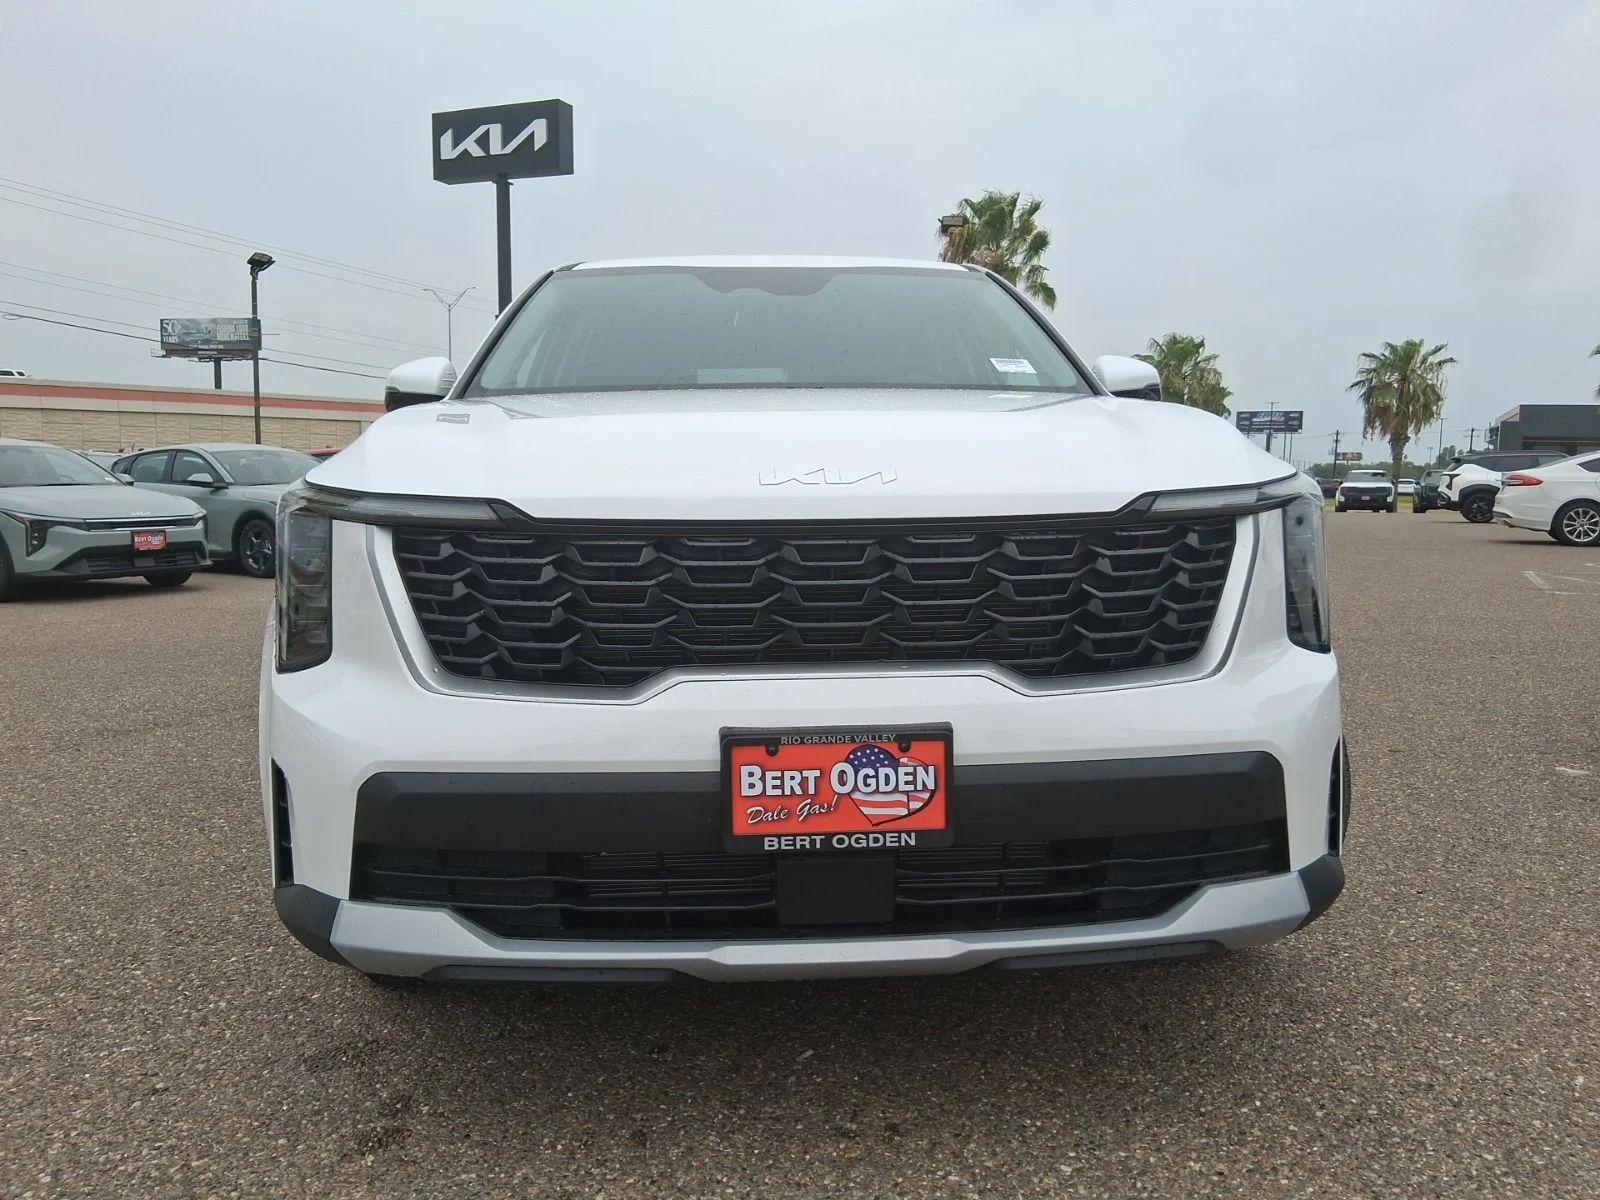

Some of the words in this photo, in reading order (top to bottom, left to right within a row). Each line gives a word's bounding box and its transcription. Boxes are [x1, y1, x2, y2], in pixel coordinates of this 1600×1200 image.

[440, 118, 547, 160] KIA
[759, 465, 897, 485] KIA
[780, 736, 801, 745] RIO
[804, 735, 851, 745] GRANDE
[854, 734, 896, 743] VALLEY
[740, 765, 821, 797] BERT
[830, 762, 935, 795] OGDEN
[747, 805, 788, 824] Dale
[796, 795, 838, 822] Gas!
[764, 835, 825, 851] BERT
[832, 832, 916, 849] OGDEN
